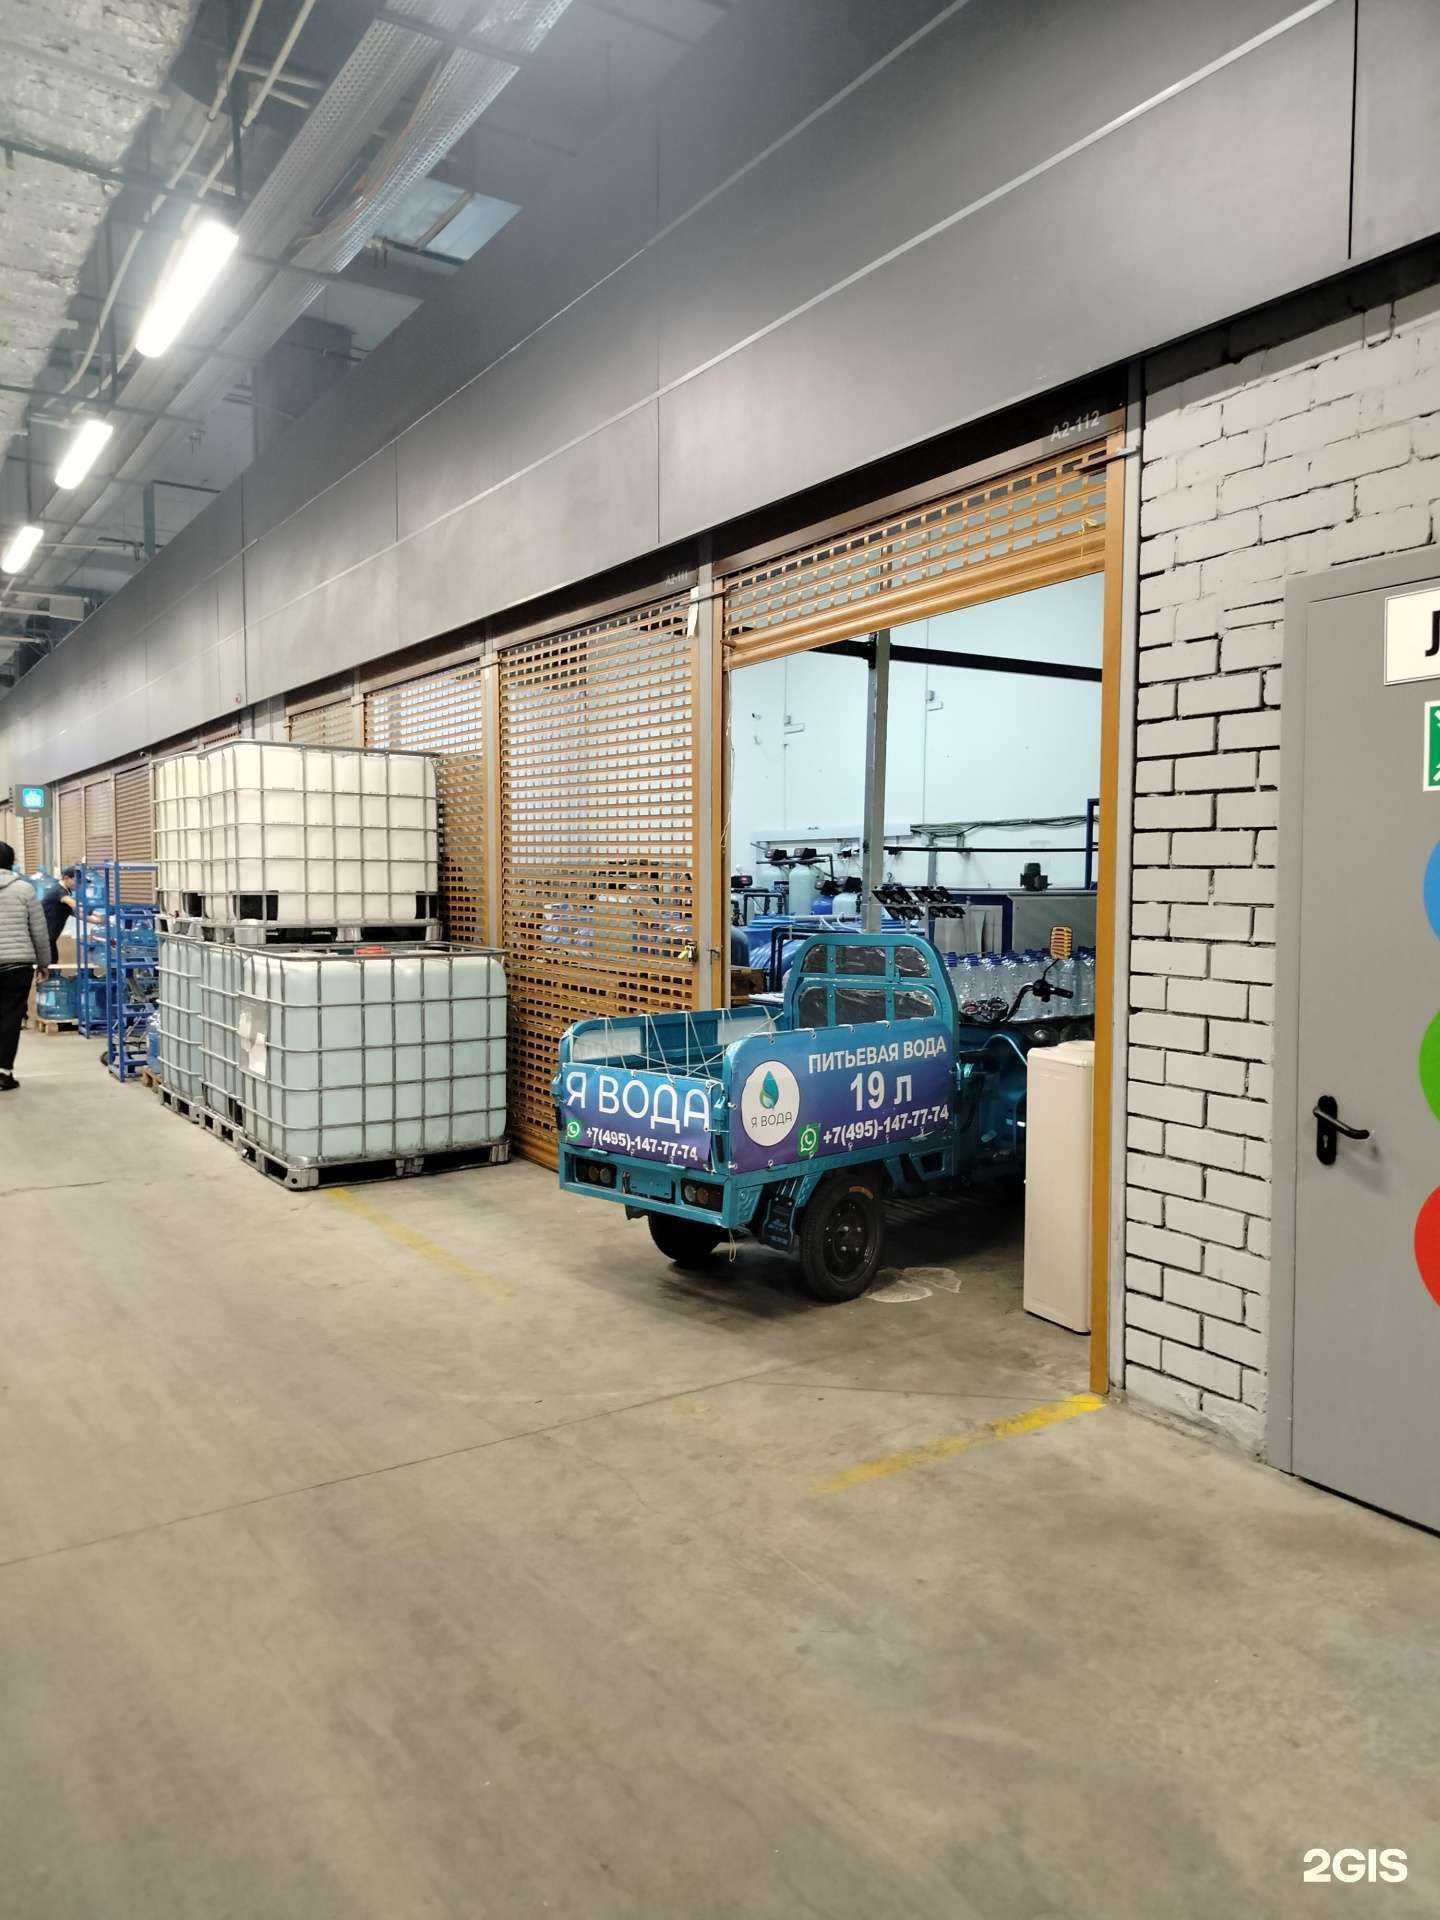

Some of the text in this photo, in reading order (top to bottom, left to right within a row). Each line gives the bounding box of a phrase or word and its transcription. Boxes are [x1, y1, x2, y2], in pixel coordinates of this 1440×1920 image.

[808, 1035, 948, 1074] ПИТЬЕВАЯ ВОДА
[566, 1071, 710, 1134] Я ВОДА
[850, 1070, 885, 1111] 19
[750, 1111, 793, 1128] Я ВОДА
[823, 1104, 949, 1146] +7(495)-147-77-74
[586, 1126, 698, 1161] +7(495)-147-77-74
